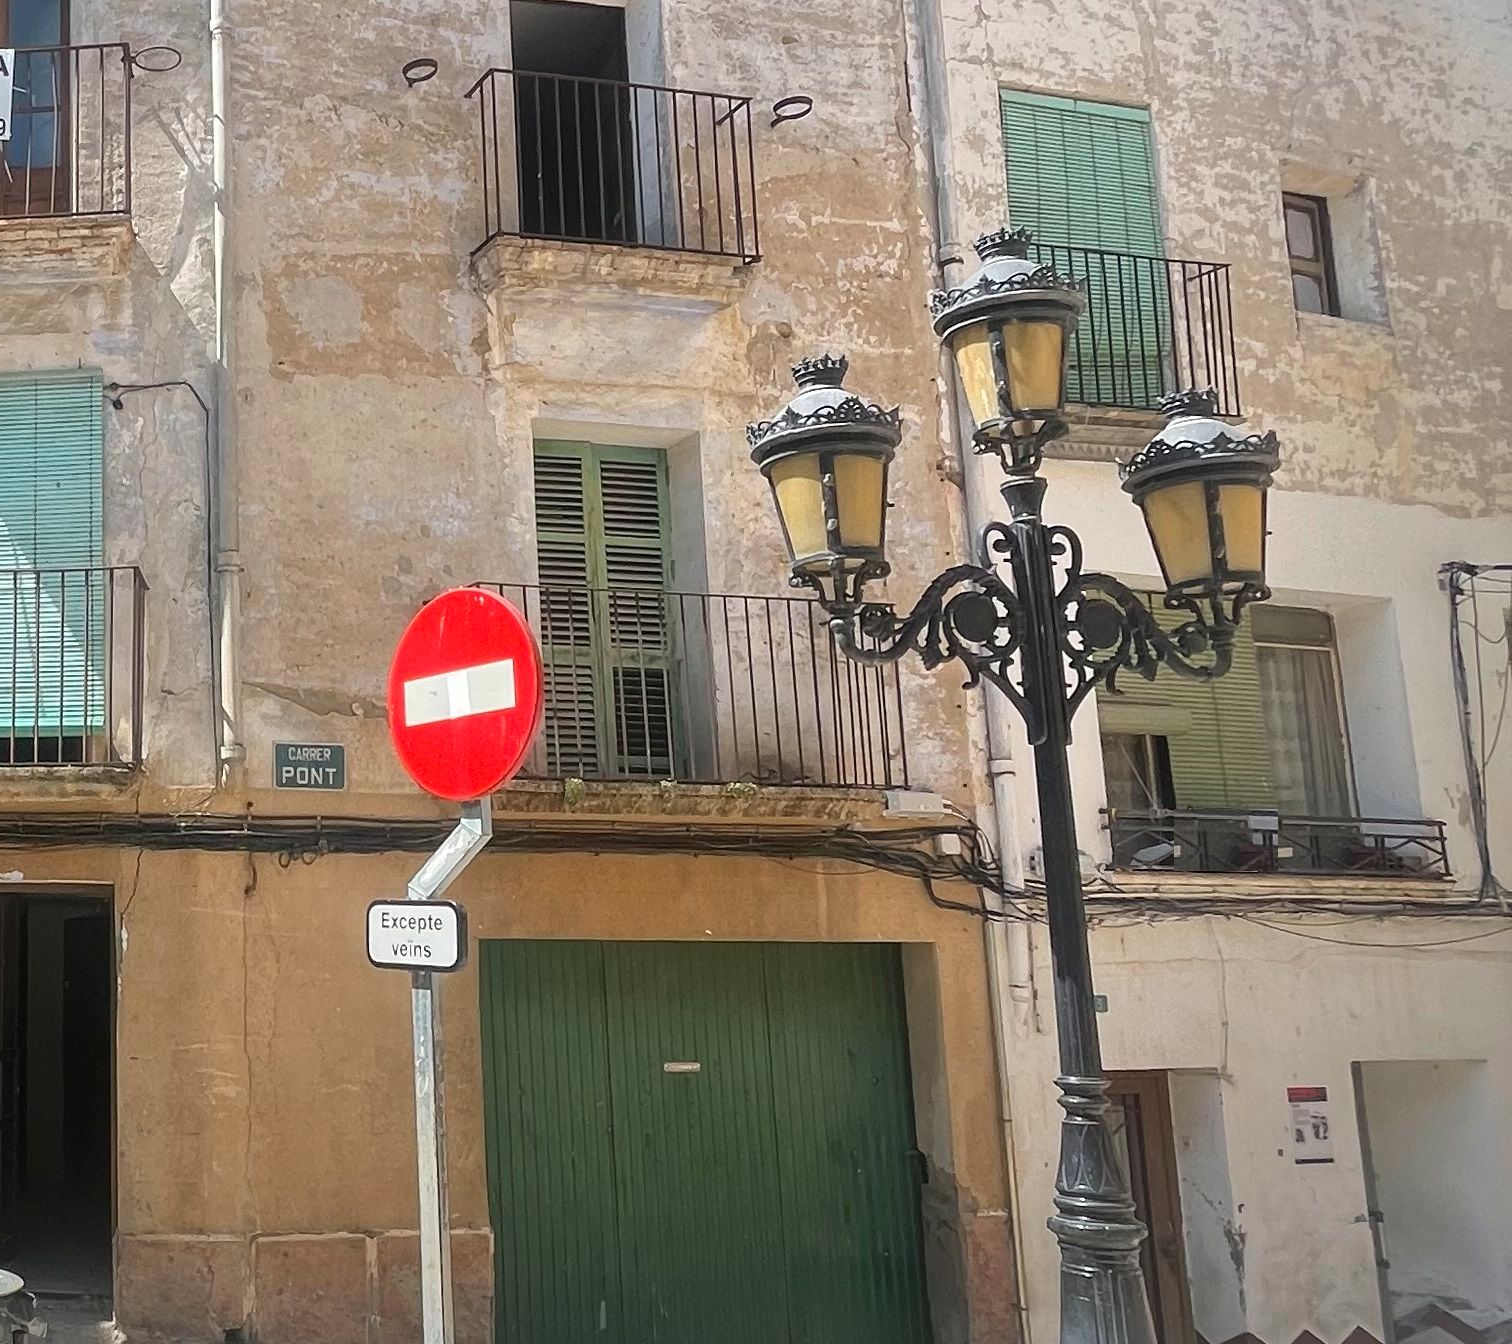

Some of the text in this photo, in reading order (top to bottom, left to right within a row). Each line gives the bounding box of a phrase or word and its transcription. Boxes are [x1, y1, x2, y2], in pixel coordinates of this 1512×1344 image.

[288, 746, 331, 762] CARRER
[282, 766, 337, 785] PONT
[381, 912, 443, 934] Excepte
[391, 939, 432, 958] veïns
